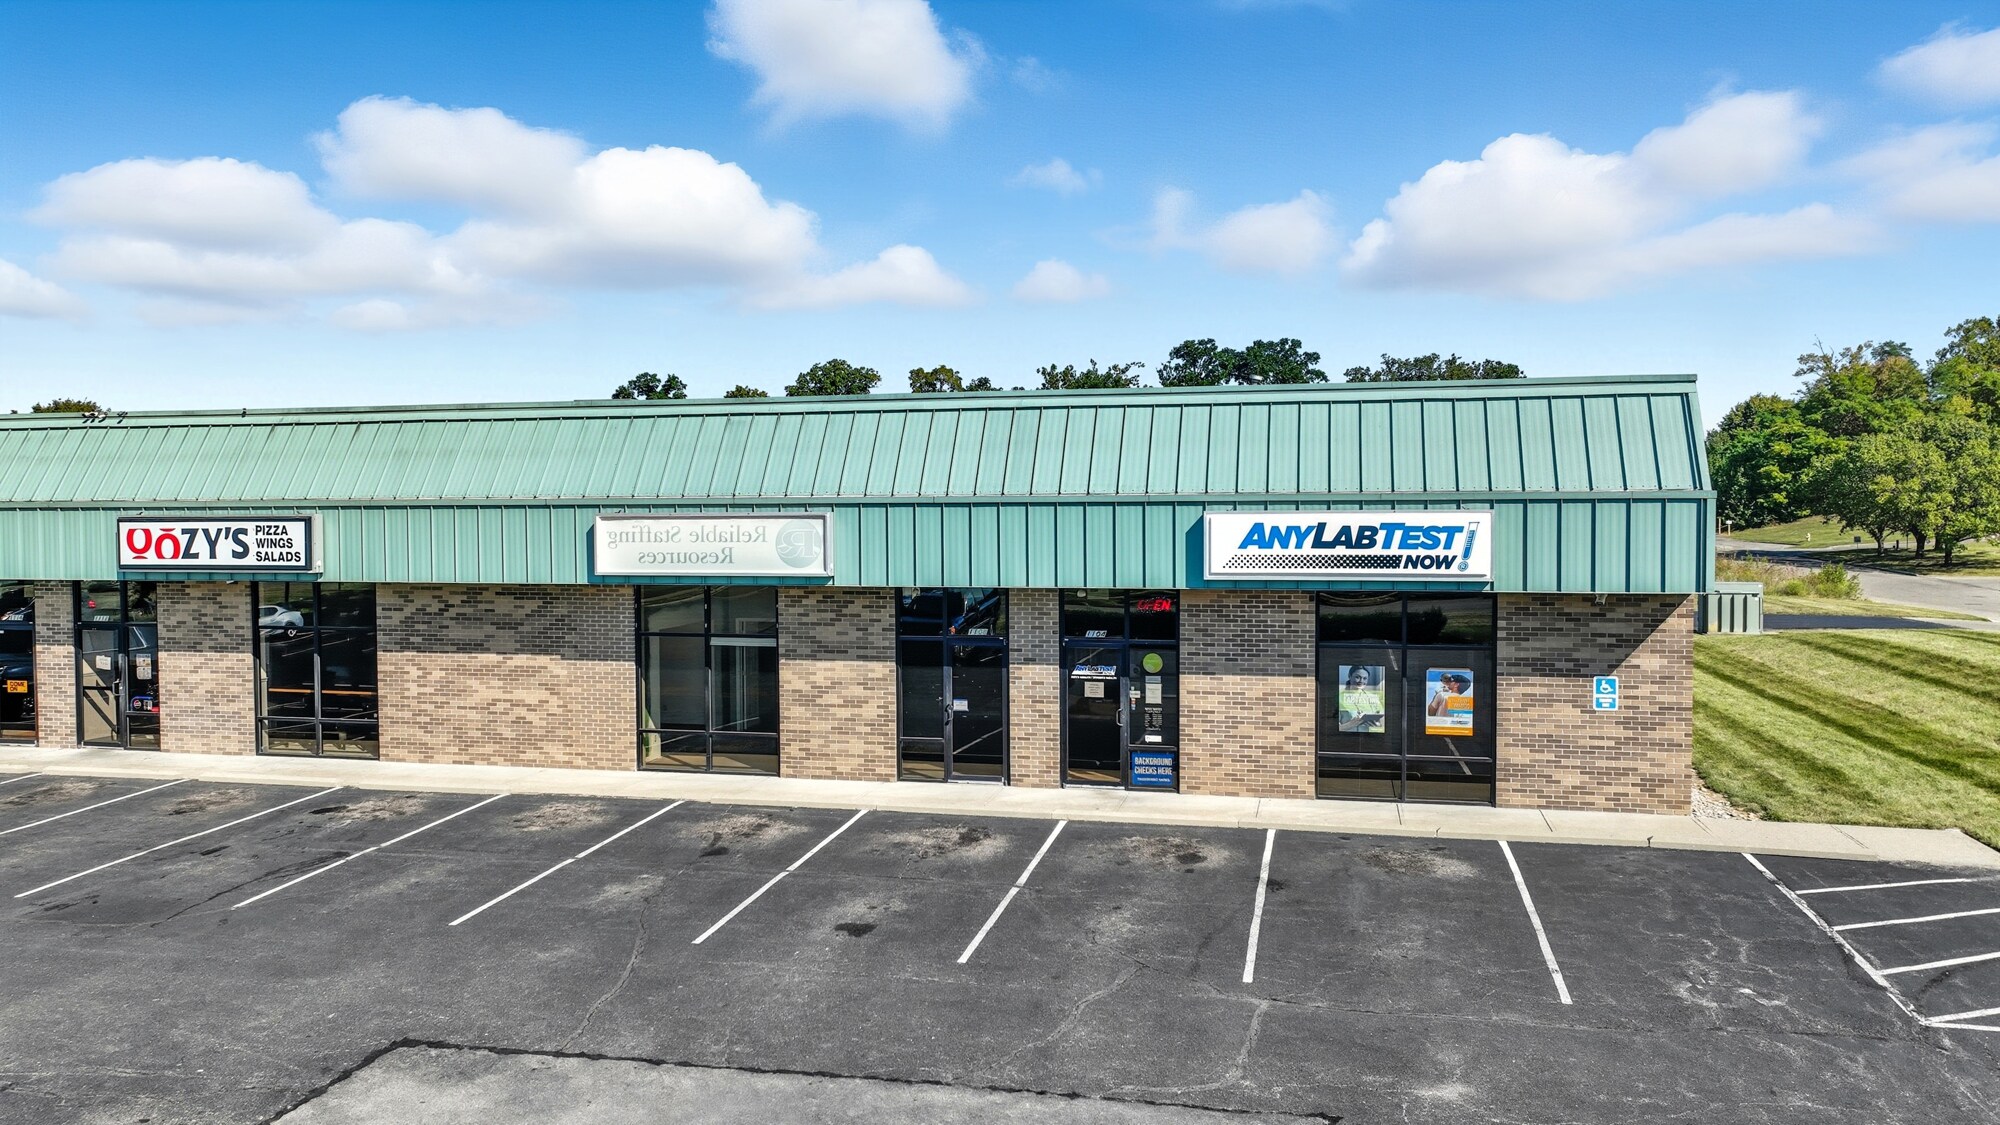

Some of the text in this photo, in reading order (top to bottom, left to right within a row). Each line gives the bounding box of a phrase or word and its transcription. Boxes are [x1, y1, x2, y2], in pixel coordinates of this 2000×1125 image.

[255, 525, 288, 536] PIZZA
[255, 538, 293, 549] WINGS
[256, 551, 302, 563] SALADS
[1402, 554, 1457, 570] NOW
[1137, 599, 1171, 611] OPEN
[1135, 757, 1172, 766] BACKGROUND
[1135, 766, 1172, 775] CHECKS HERE
